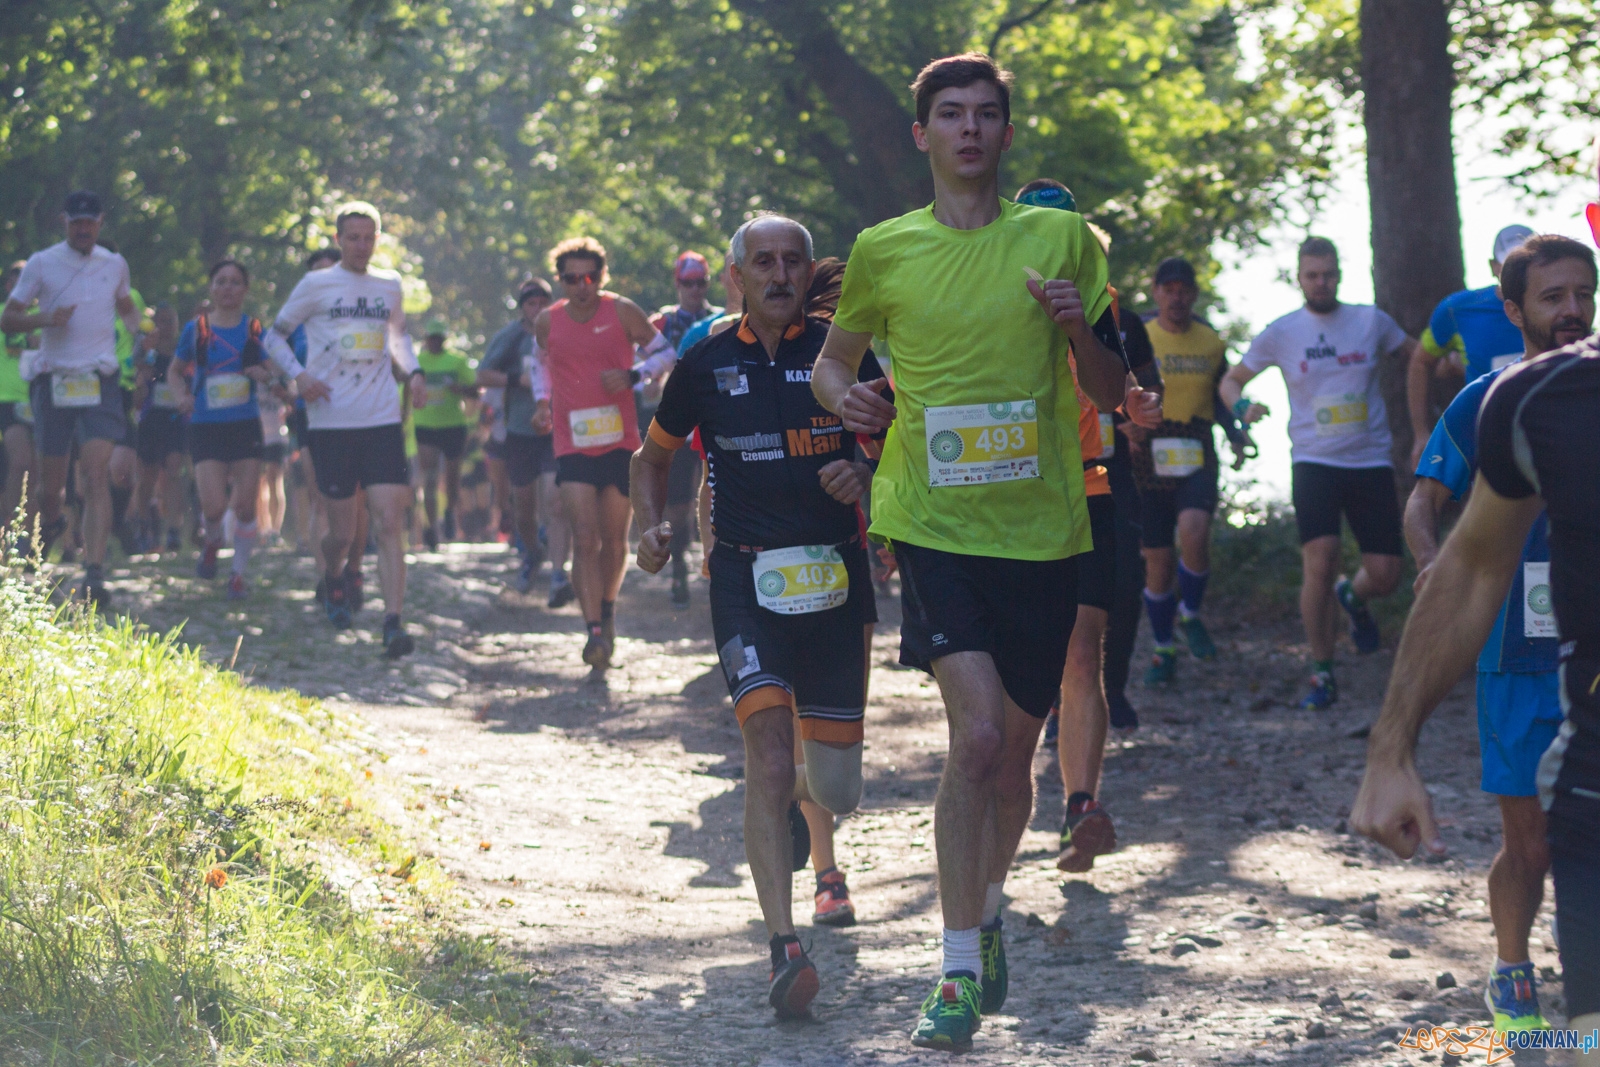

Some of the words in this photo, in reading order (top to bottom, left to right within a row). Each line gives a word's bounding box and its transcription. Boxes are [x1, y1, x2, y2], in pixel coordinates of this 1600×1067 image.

[810, 416, 841, 427] TEAM
[786, 428, 842, 457] Man
[975, 426, 1025, 452] 493
[741, 448, 785, 462] Czempiń
[796, 565, 837, 587] 403
